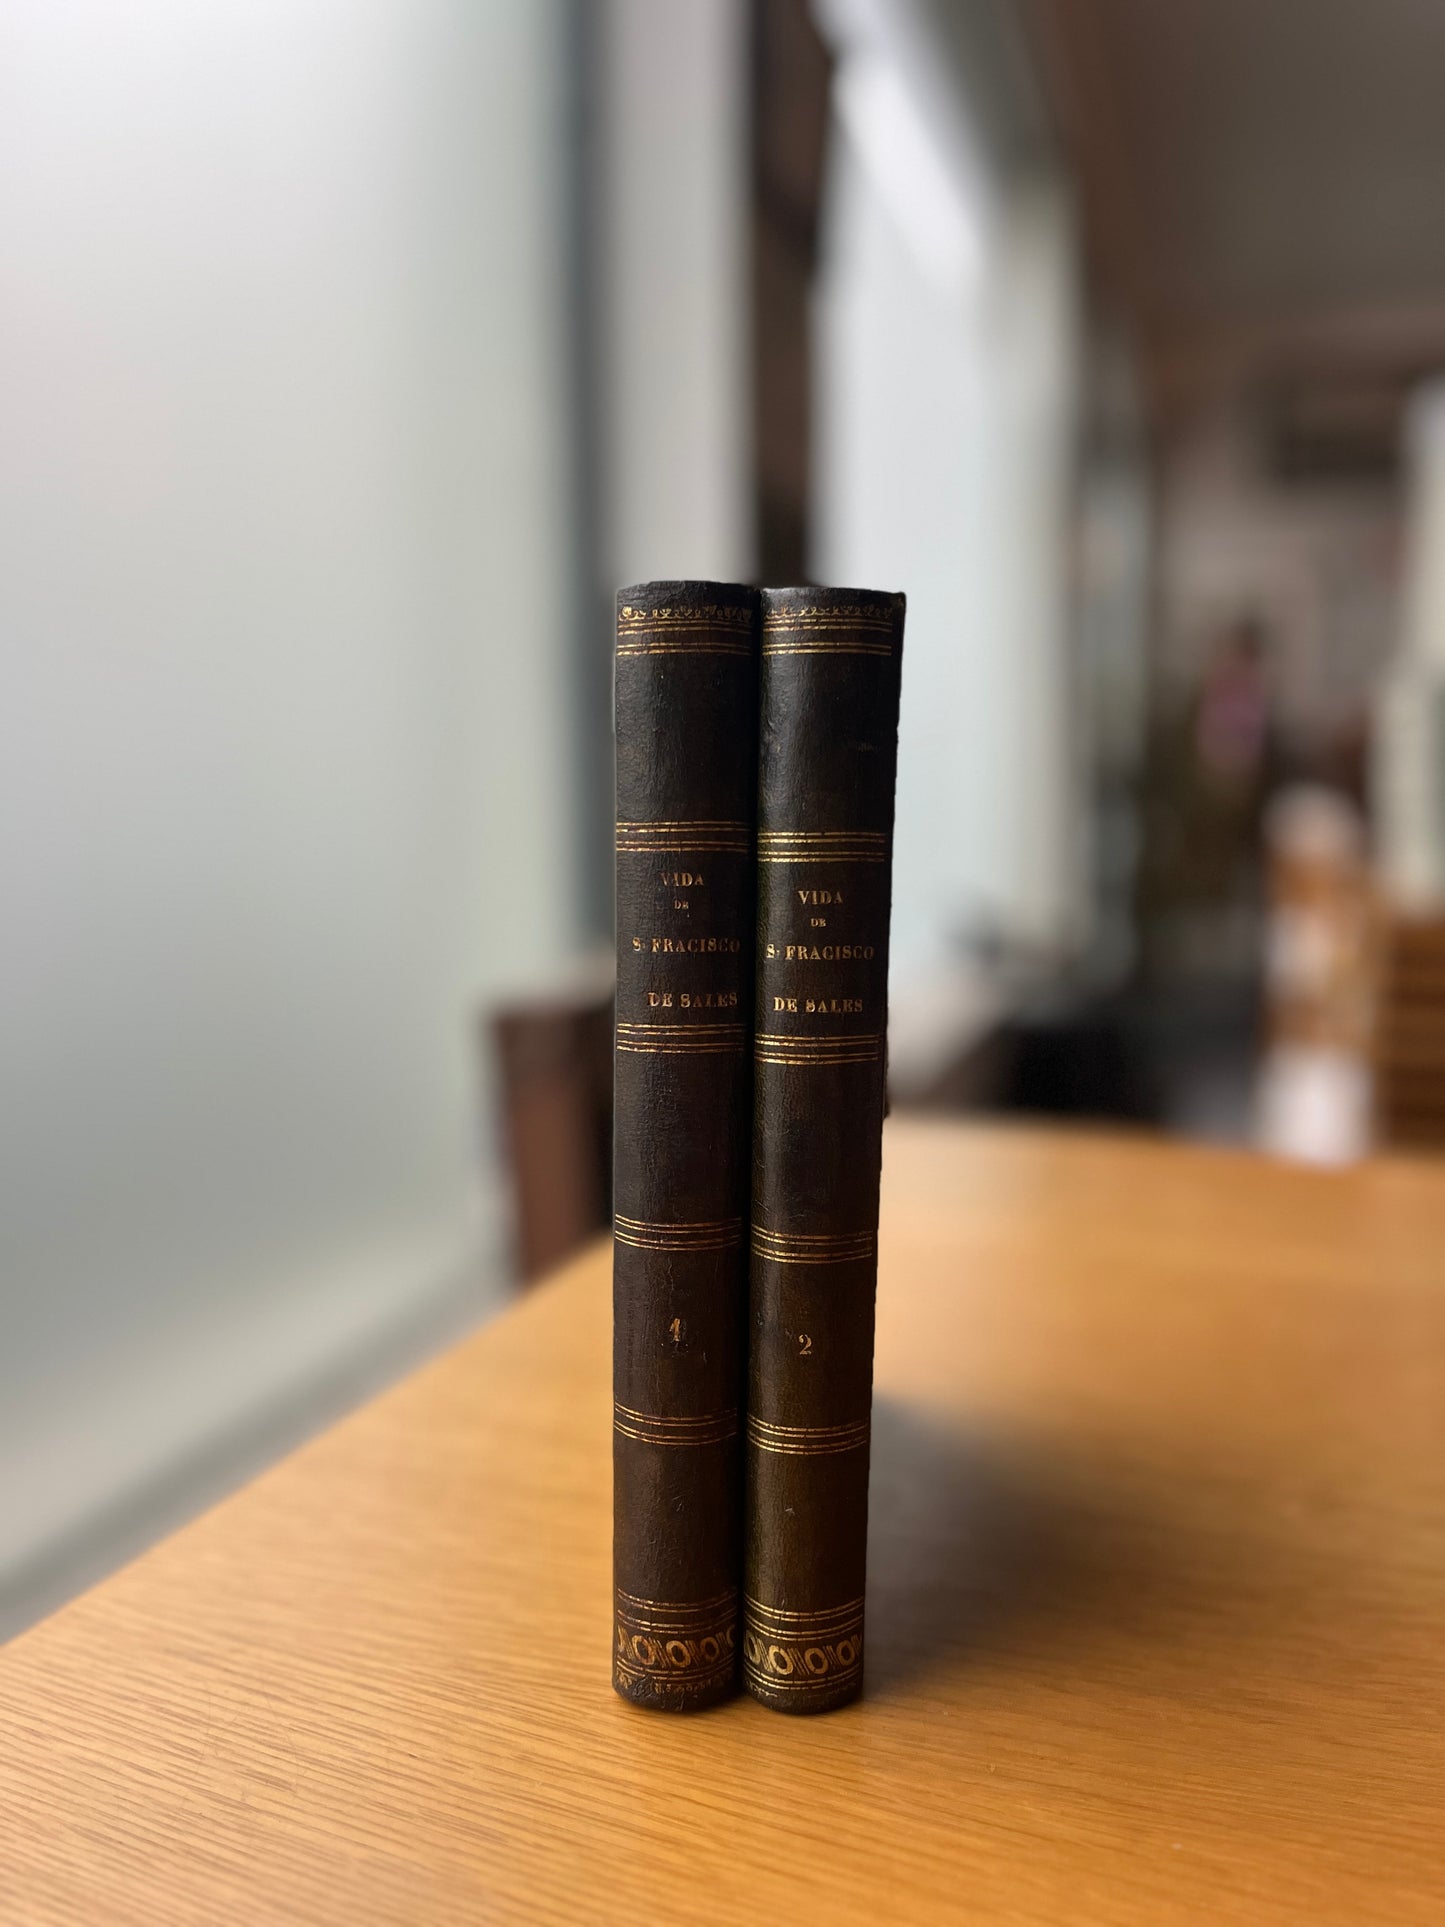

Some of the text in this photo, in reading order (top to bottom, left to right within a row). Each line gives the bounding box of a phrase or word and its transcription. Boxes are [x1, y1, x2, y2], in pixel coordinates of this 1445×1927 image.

[660, 872, 705, 887] VIDA
[798, 890, 844, 905] VIDA
[810, 918, 827, 928] DE
[651, 938, 741, 953] FRACISCO
[785, 945, 875, 960] FRACISCO
[647, 992, 738, 1008] DE SALES
[773, 997, 863, 1013] DE SALES
[798, 1334, 812, 1355] 2
